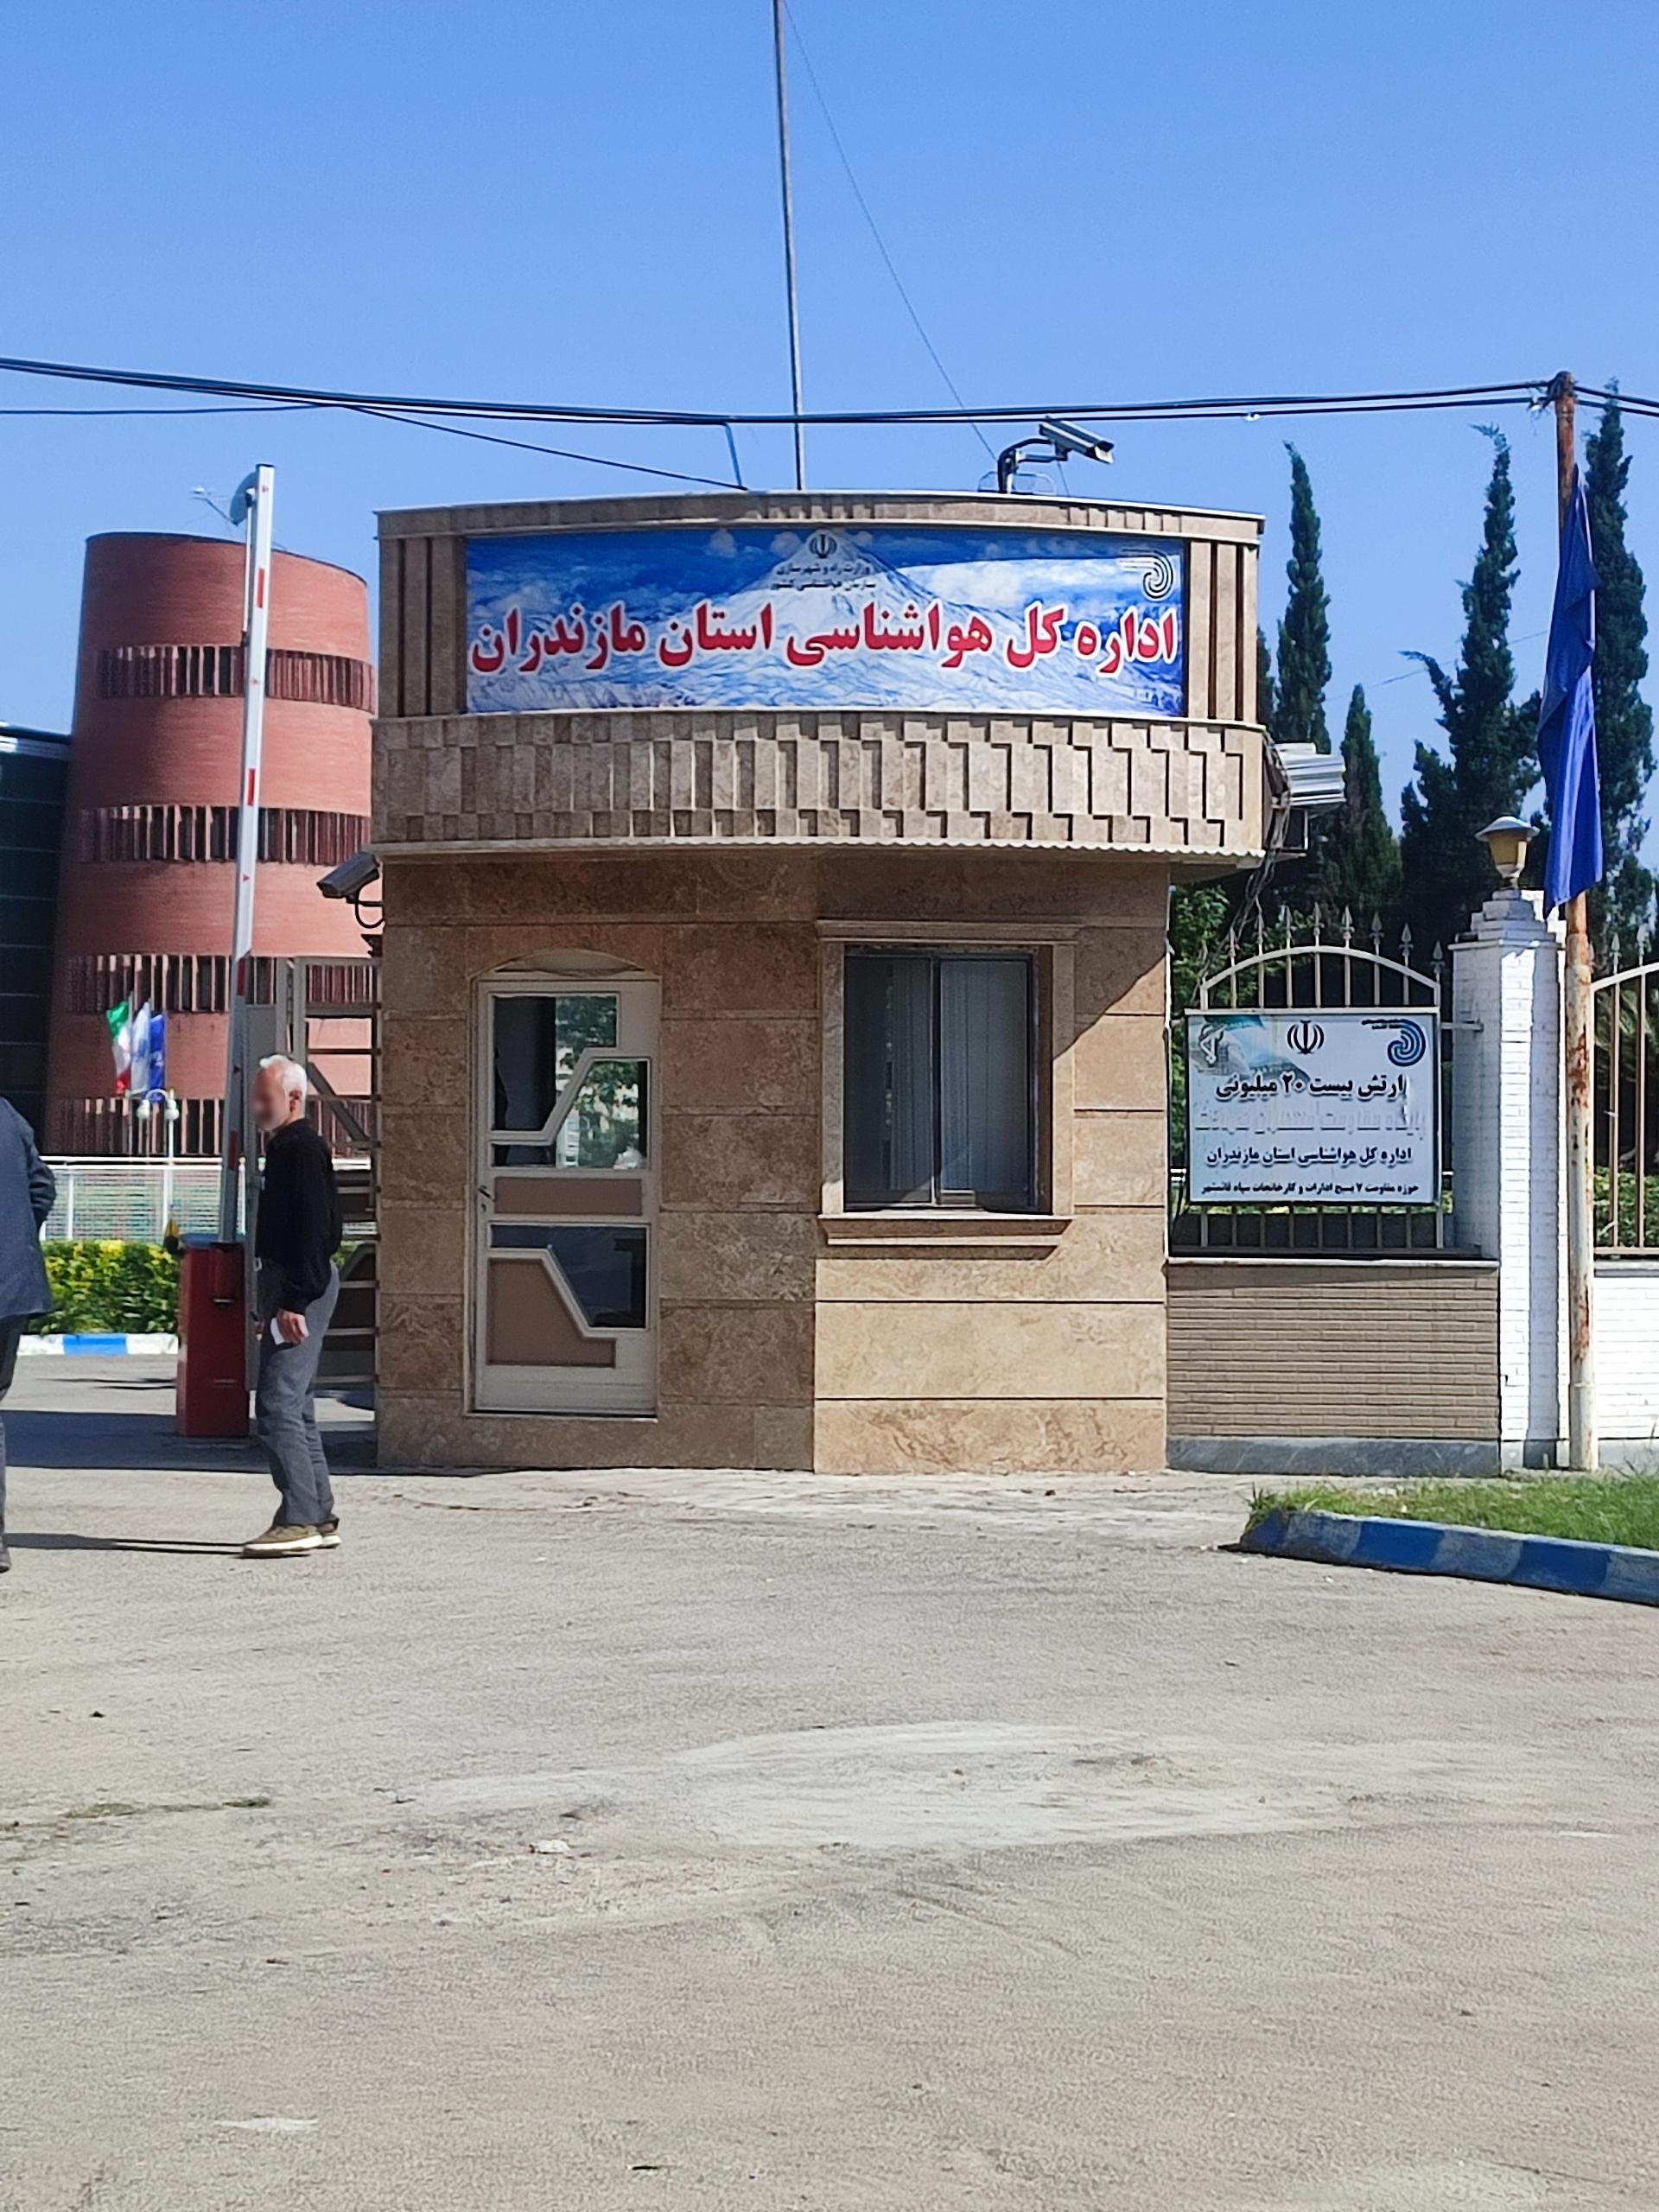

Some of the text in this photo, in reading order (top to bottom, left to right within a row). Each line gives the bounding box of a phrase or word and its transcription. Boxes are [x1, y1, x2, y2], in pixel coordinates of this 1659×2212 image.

[472, 601, 1179, 674] اداره کل هواشناسی استان مازندران
[1216, 1074, 1403, 1098] ارتش بیست ۲۰ میلیونی
[1207, 1146, 1412, 1164] اداره کل هواشناسی استان مازندران
